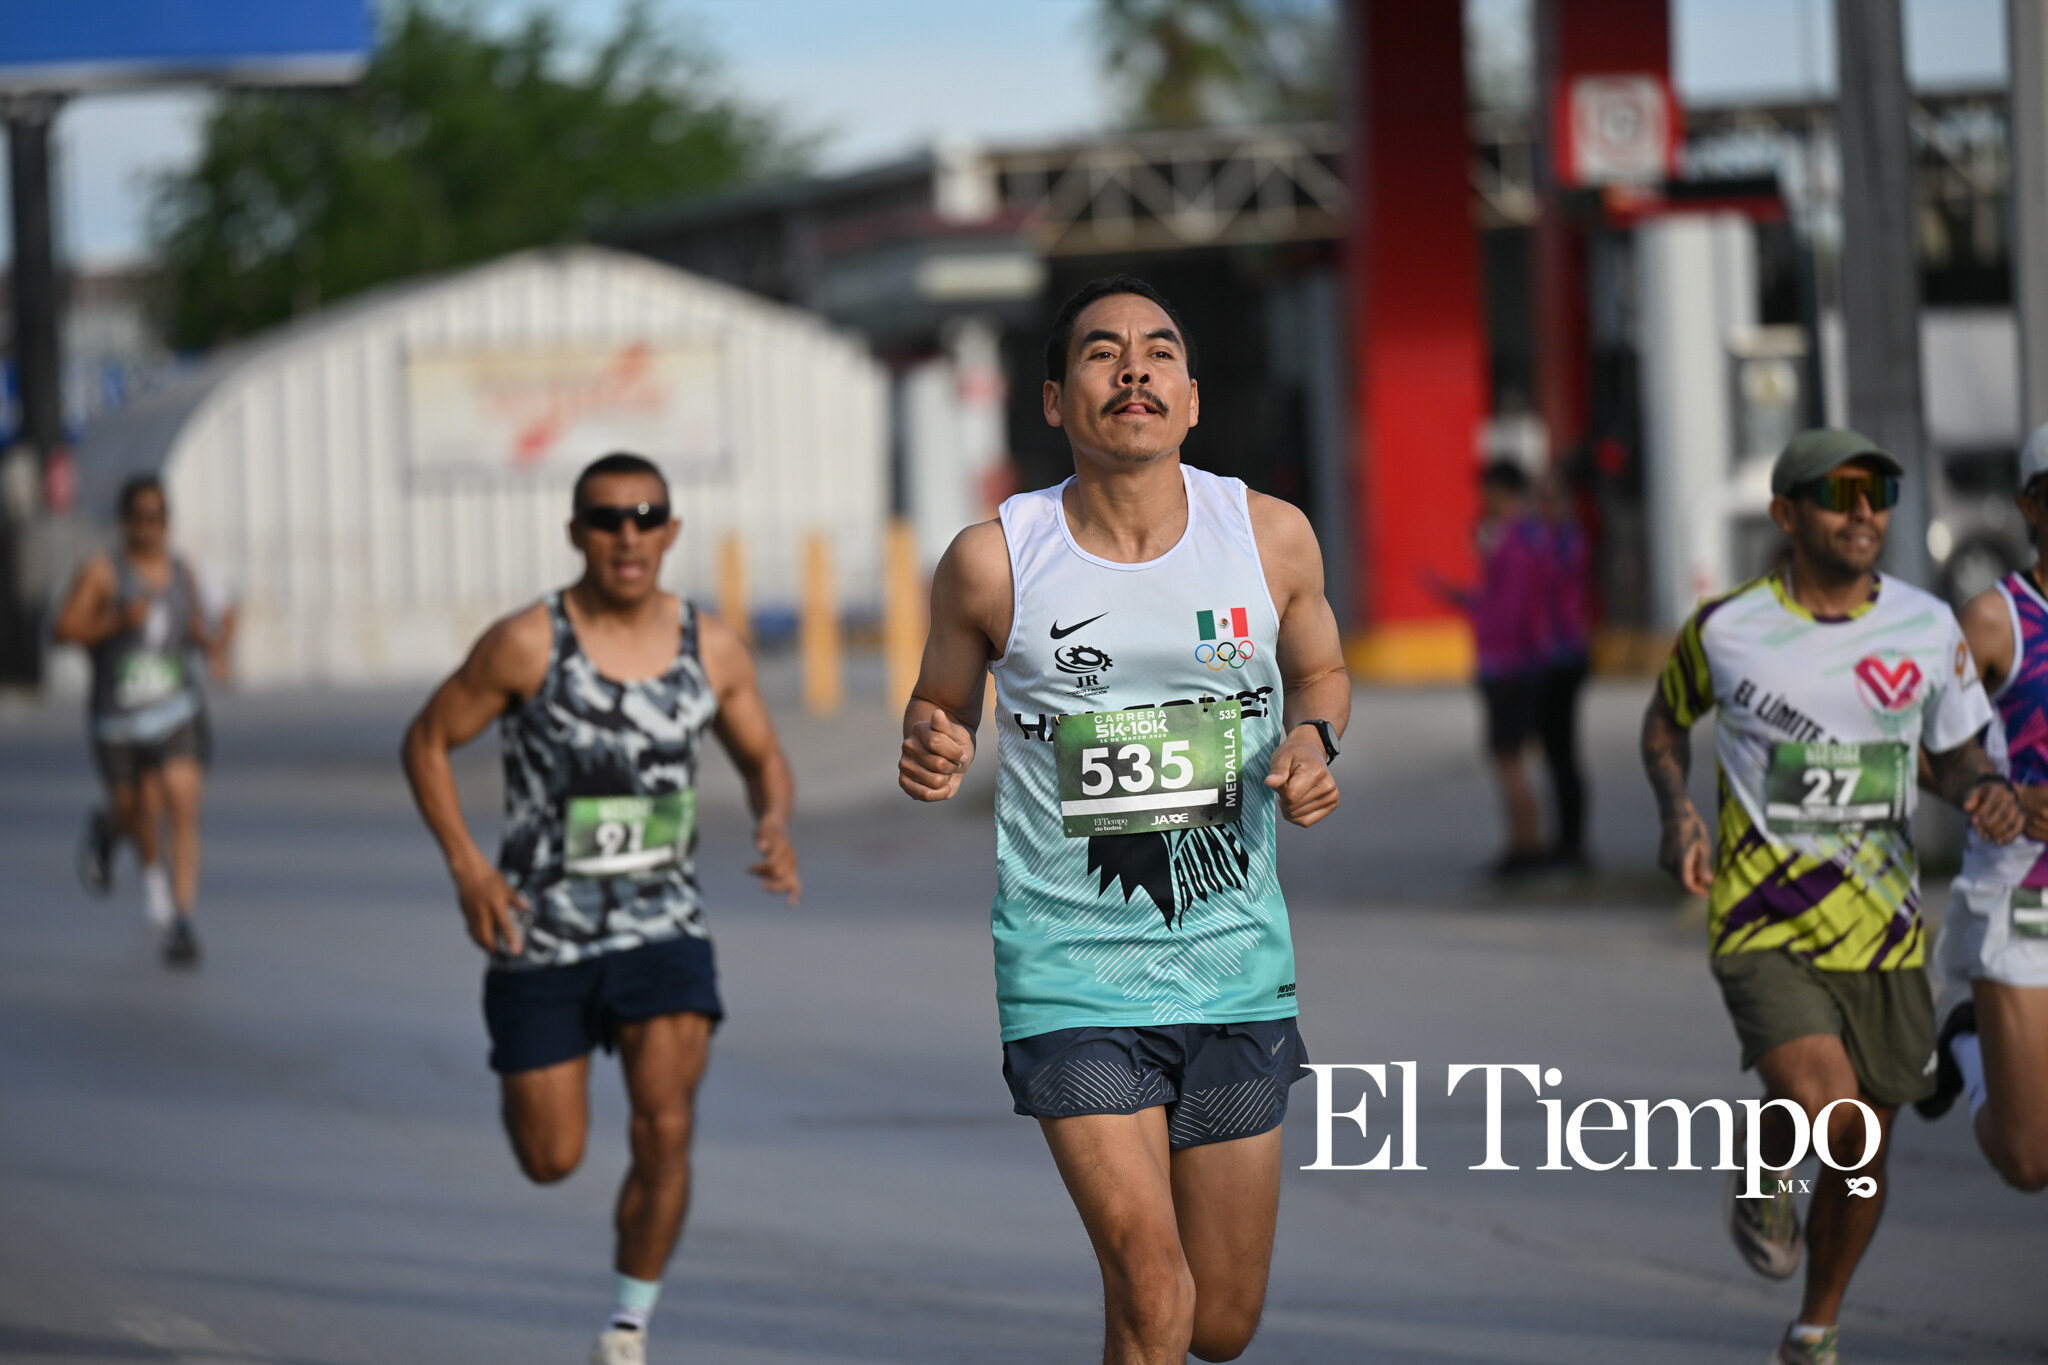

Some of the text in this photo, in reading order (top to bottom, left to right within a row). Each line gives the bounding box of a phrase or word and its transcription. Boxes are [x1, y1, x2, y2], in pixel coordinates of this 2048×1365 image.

[1075, 674, 1100, 688] JR
[1733, 679, 1757, 709] EL
[1094, 710, 1167, 724] CARRERA
[1219, 709, 1237, 721] 535
[1081, 740, 1194, 796] 535
[1223, 728, 1236, 808] MEDALLA
[1802, 767, 1862, 806] 27
[1094, 818, 1102, 826] El
[1102, 817, 1128, 826] Tiempo
[596, 821, 644, 857] 91
